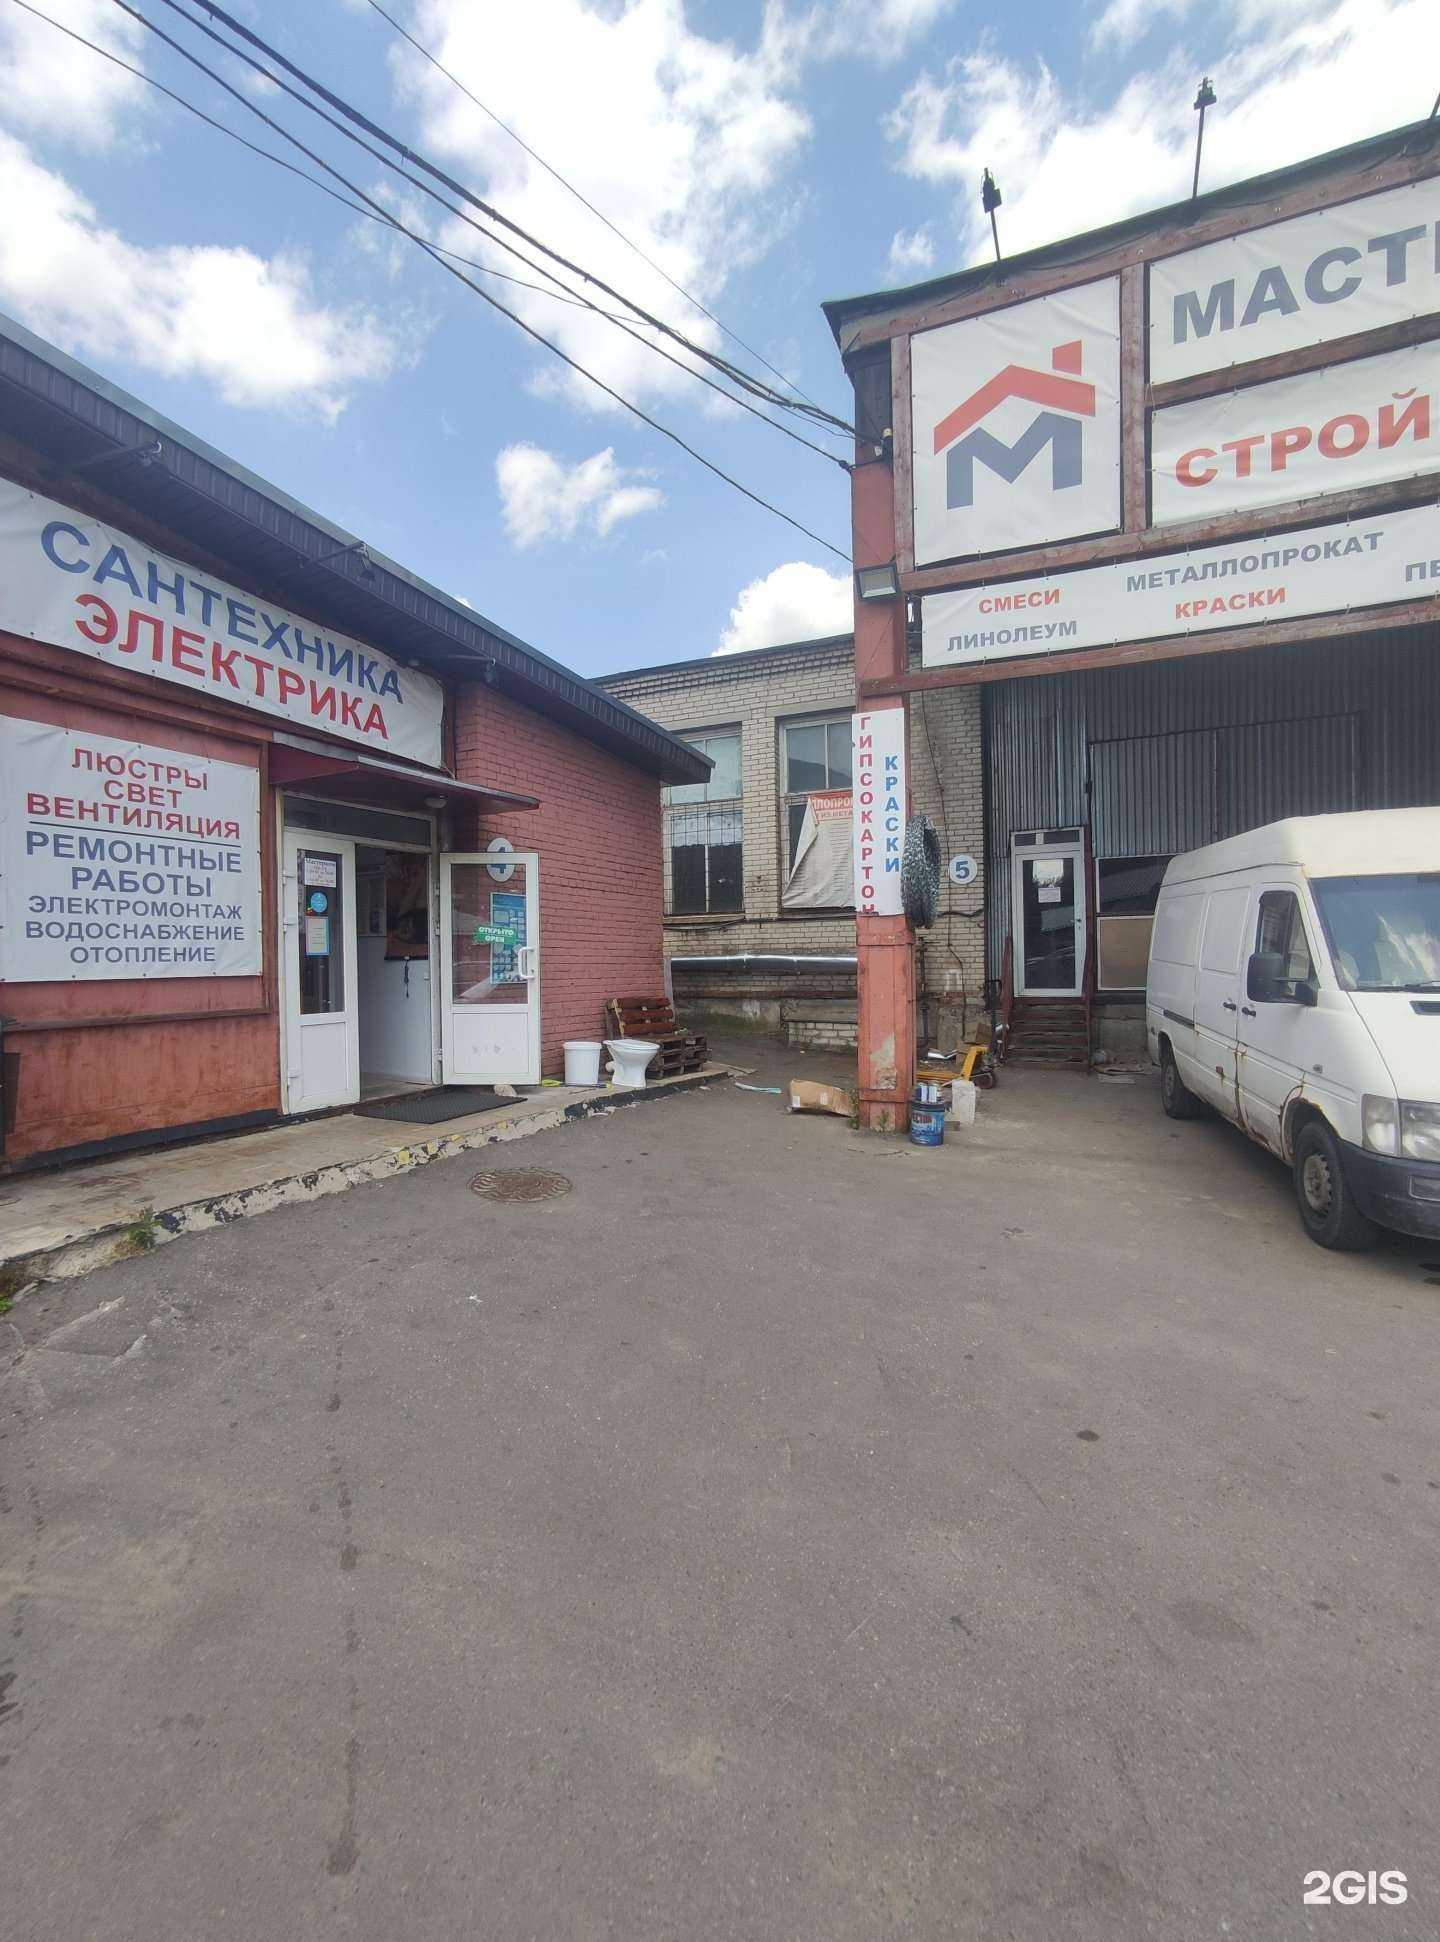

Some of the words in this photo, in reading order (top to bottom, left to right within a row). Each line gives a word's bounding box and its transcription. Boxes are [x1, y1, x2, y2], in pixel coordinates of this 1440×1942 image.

[1175, 387, 1430, 488] СТРОЙ
[1126, 531, 1384, 592] МЕТАЛЛОПРОКАТ
[40, 521, 404, 704] САНТЕХНИКА
[978, 588, 1060, 614] СМЕСИ
[1175, 587, 1286, 620] КРАСКИ
[947, 620, 1077, 651] ЛИНОЛЕУМ
[75, 594, 389, 740] ЭЛЕКТРИКА
[72, 748, 208, 791] ЛЮСТРЫ
[103, 780, 182, 808] СВЕТ
[27, 792, 240, 839] ВЕНТИЛЯЦИЯ
[884, 755, 900, 873] КРАСКИ
[26, 831, 242, 873] РЕМОНТНЫЕ
[71, 867, 211, 897] РАБОТЫ
[955, 861, 970, 879] 5
[28, 895, 242, 920] ЭЛЕКТРОМОНТАЖ
[25, 921, 245, 942] ВОДОСНАБЖЕНИЕ
[479, 926, 514, 936] ОТКРЫТО
[485, 935, 506, 943] OPEN
[70, 947, 216, 963] ОТОПЛЕНИЕ
